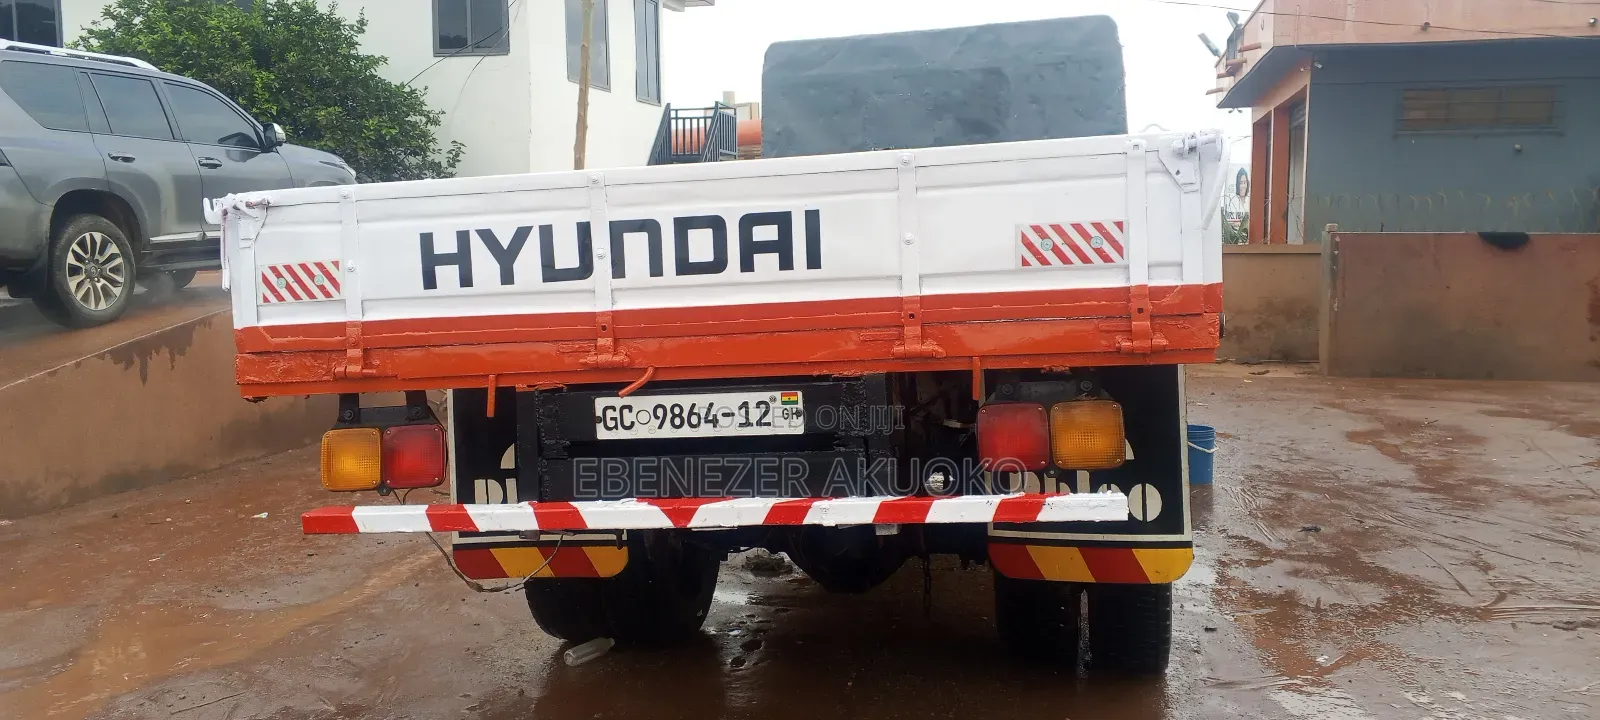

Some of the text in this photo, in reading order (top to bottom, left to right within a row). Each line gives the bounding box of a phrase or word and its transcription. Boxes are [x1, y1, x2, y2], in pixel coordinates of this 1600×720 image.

[419, 209, 822, 290] HYUNDAI
[602, 400, 772, 431] GC 9864-12
[782, 407, 802, 421] GH
